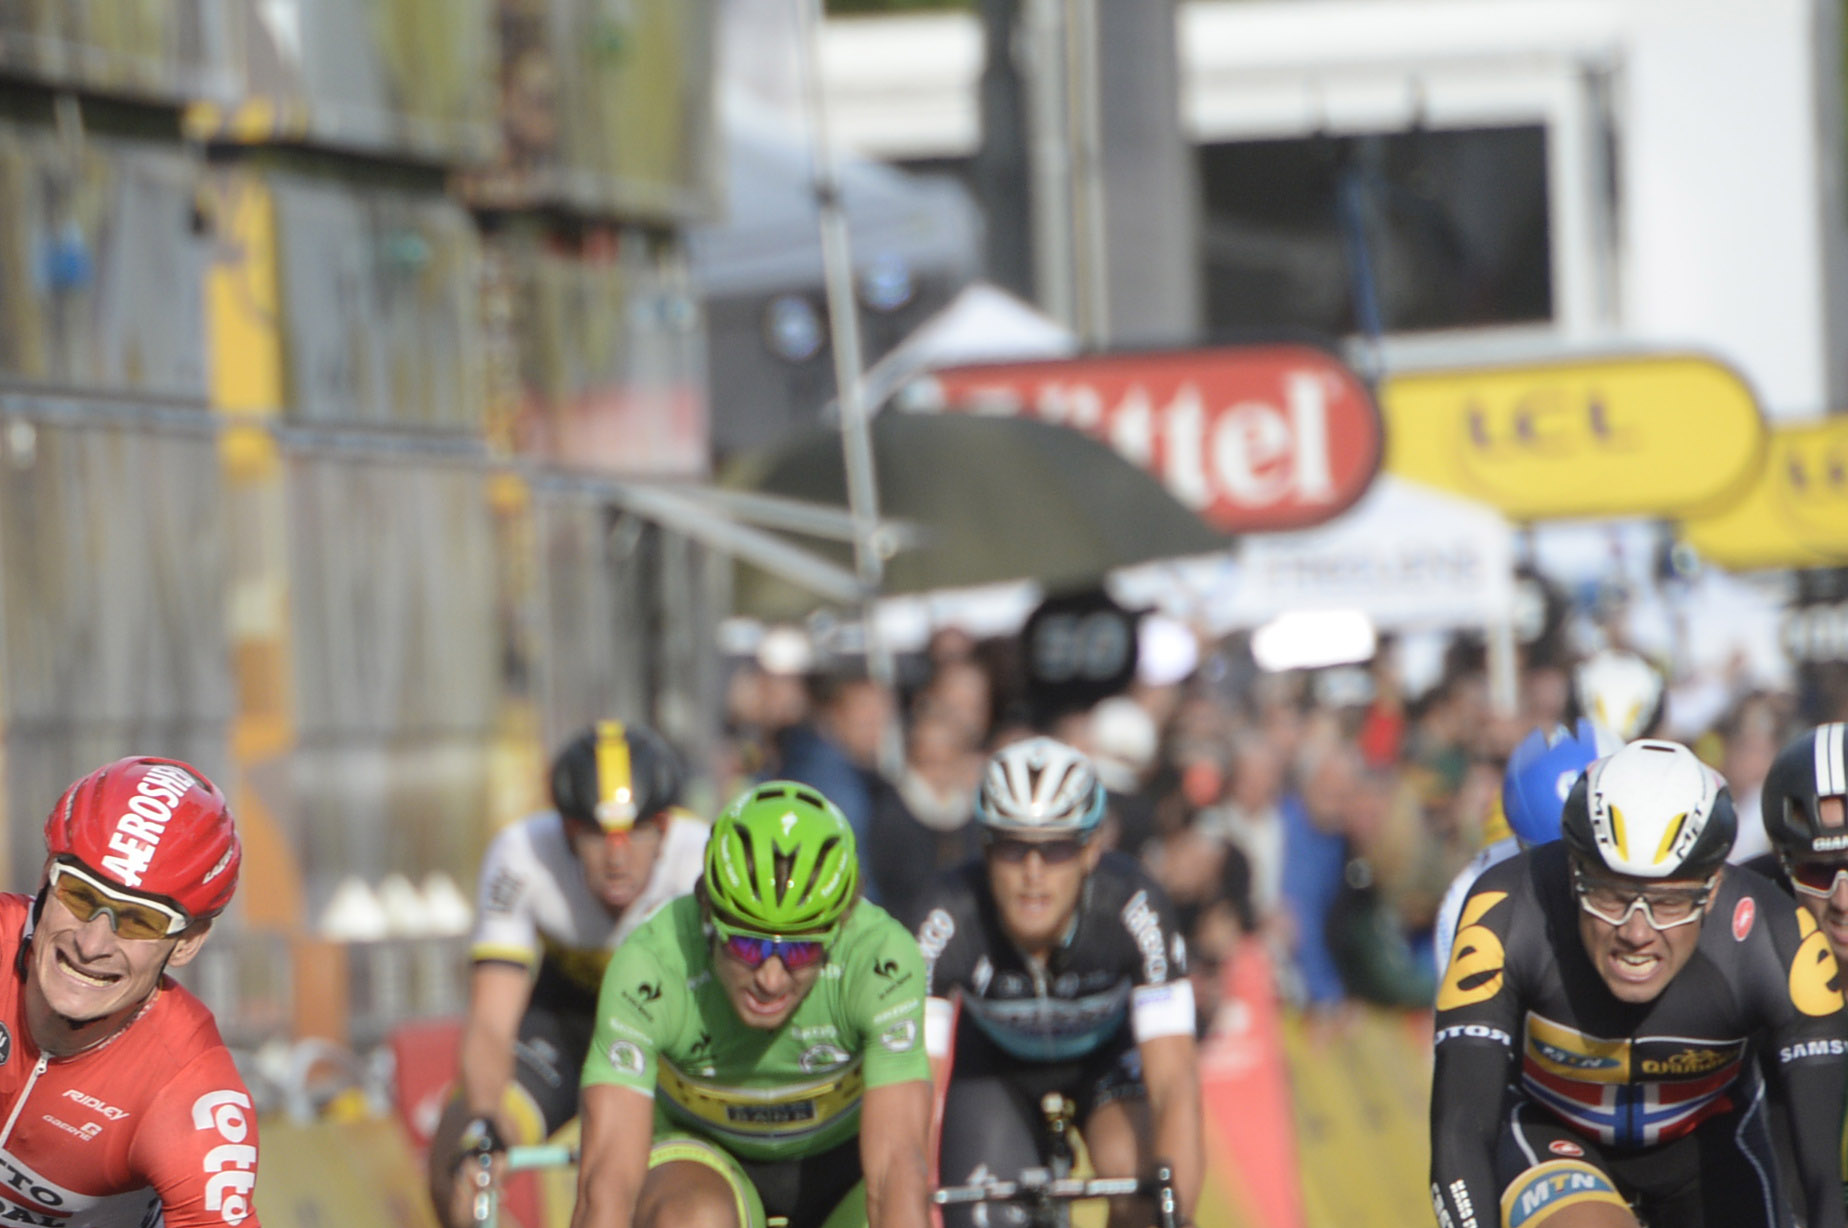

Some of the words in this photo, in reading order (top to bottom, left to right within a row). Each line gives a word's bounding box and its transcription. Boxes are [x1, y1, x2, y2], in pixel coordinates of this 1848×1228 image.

[1780, 1039, 1848, 1063] SAMS
[62, 1089, 130, 1121] RIDLEY
[1521, 1172, 1596, 1216] MTN
